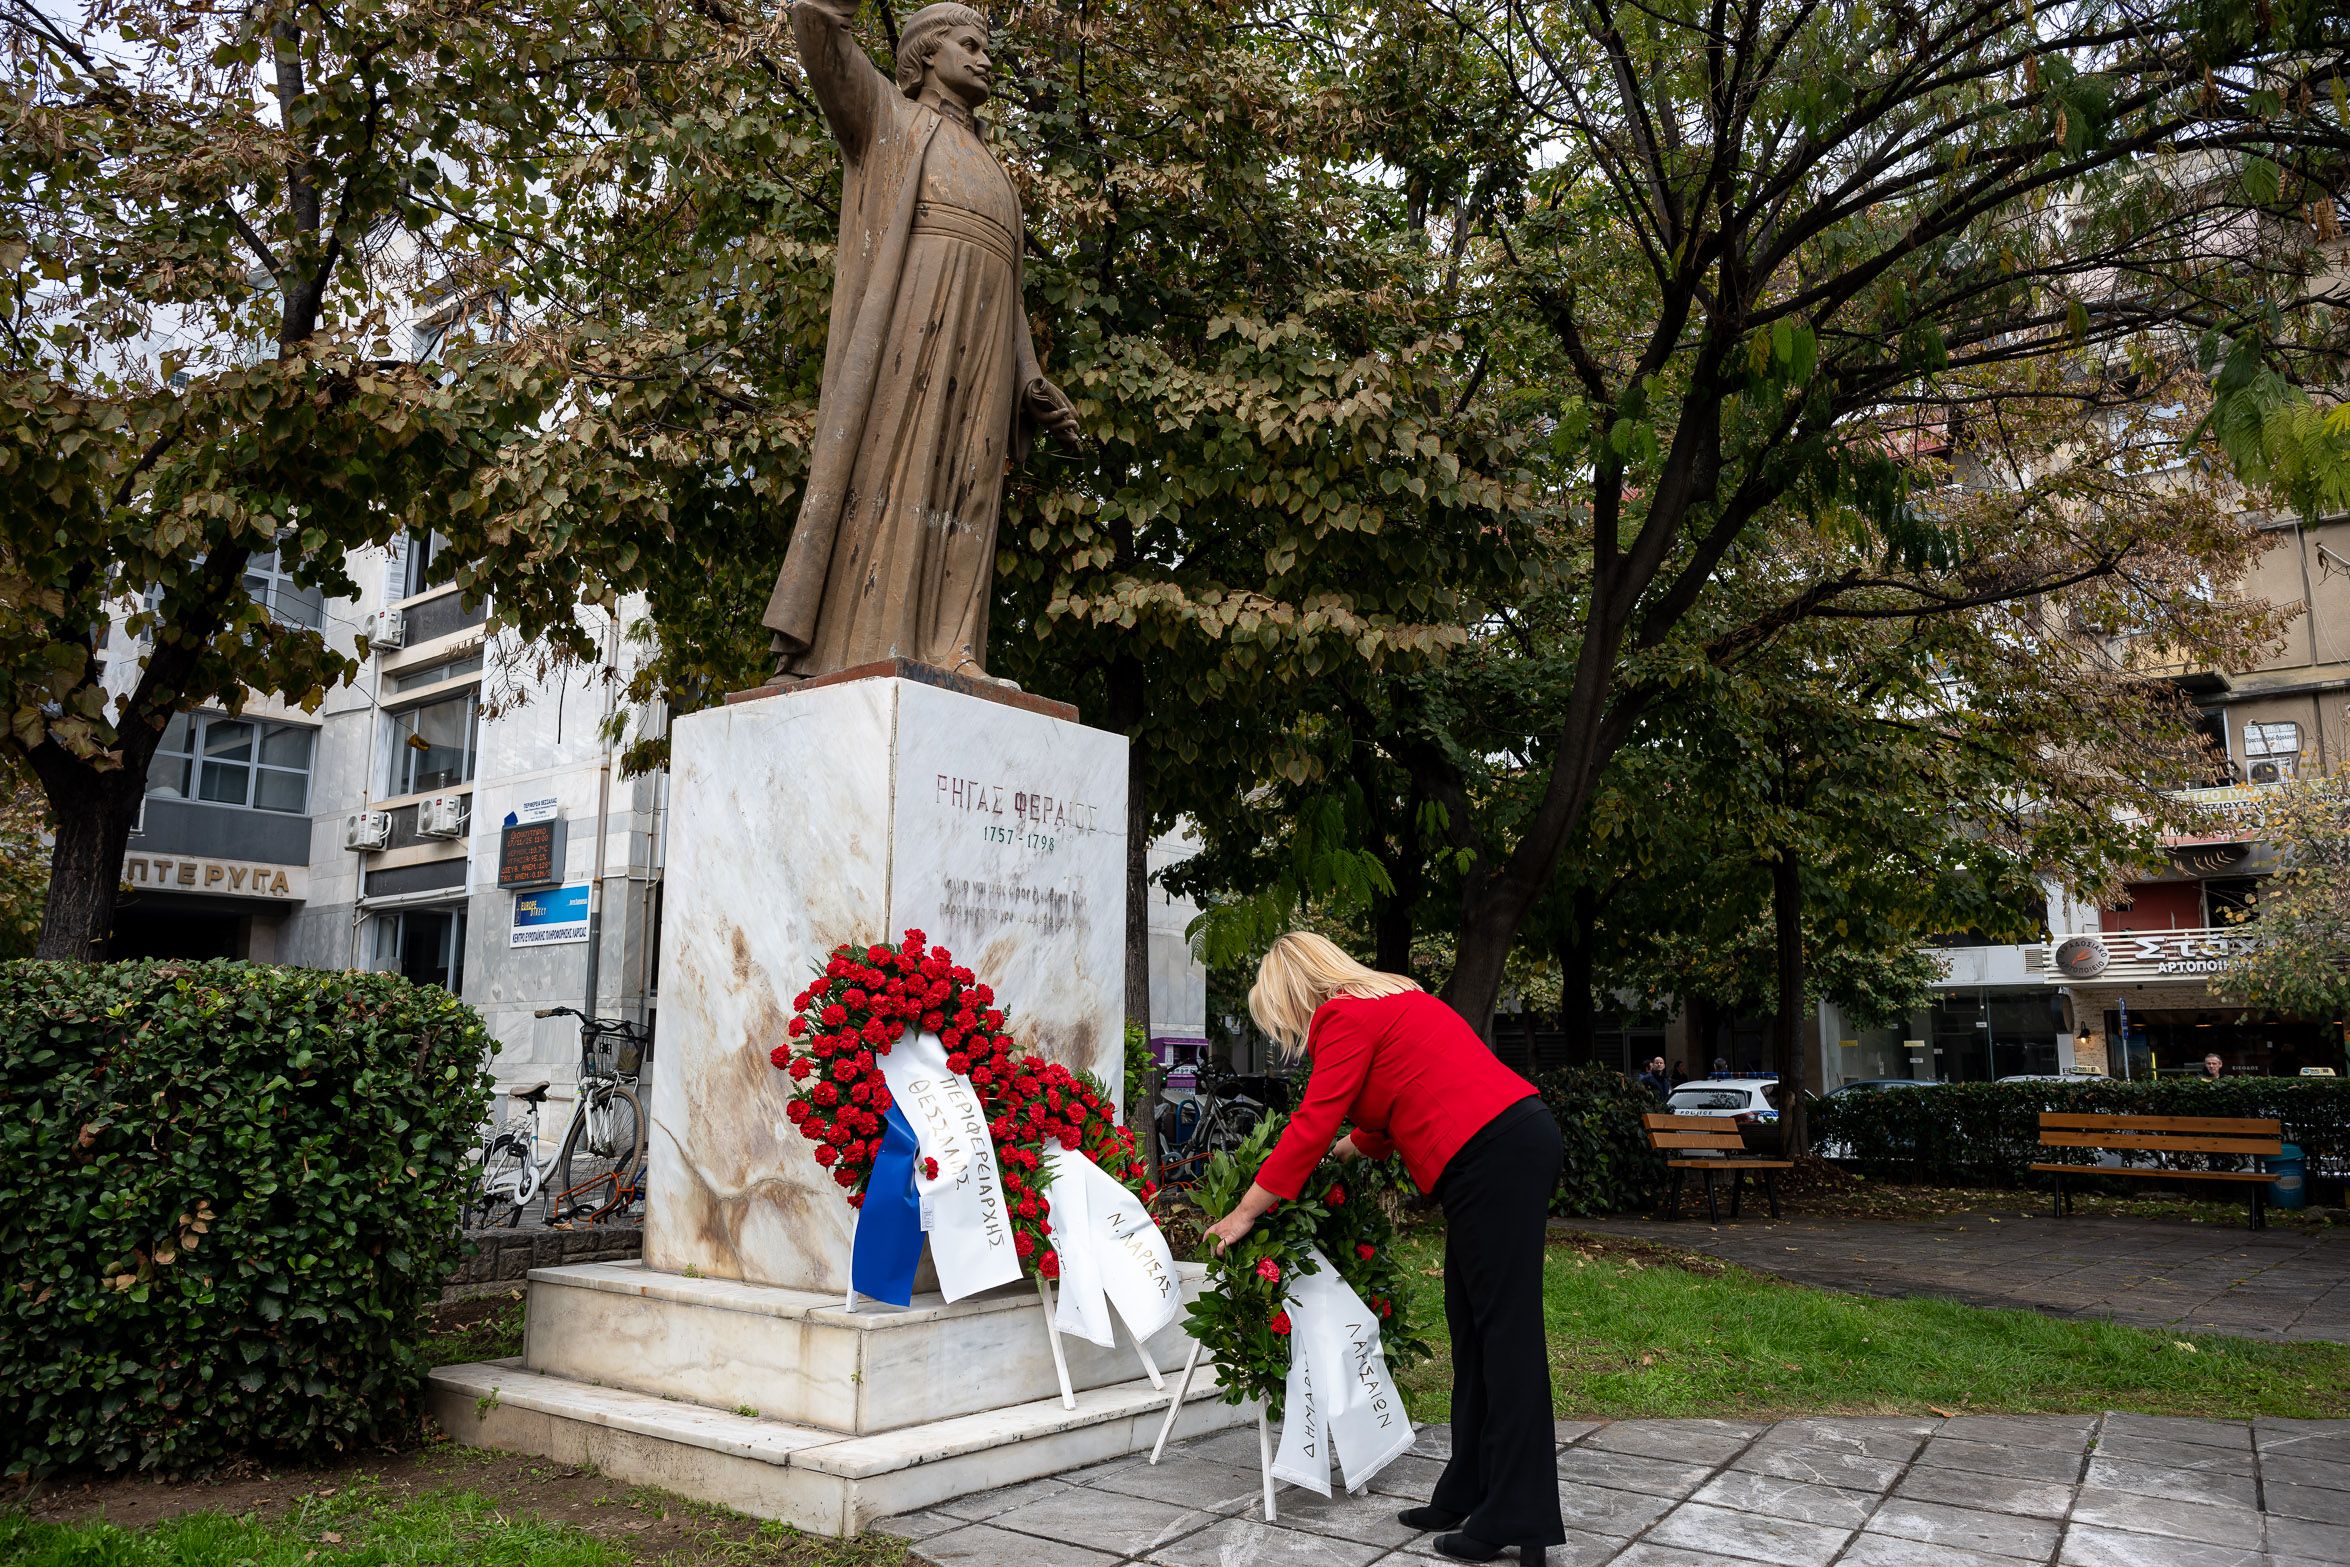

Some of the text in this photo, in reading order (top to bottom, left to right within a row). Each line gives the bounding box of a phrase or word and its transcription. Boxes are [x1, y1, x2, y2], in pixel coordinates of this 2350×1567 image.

[936, 774, 1098, 832] ΡΗΓΑΣ ΦΕΡΑΙΟΣ
[984, 826, 1014, 845] 1757
[1027, 834, 1055, 851] 1798
[127, 858, 289, 892] ΠΤΕΡΥΓΑ
[521, 901, 537, 911] EUROPE
[530, 907, 547, 917] DIRECT
[512, 932, 525, 943] ΚΕΝΤΡΟ
[572, 926, 587, 938] ΛΑΡΙΣΑΣ
[940, 1074, 1005, 1251] ΠΕΡΙΦΕΡΕΙΑΡΧΗΣ
